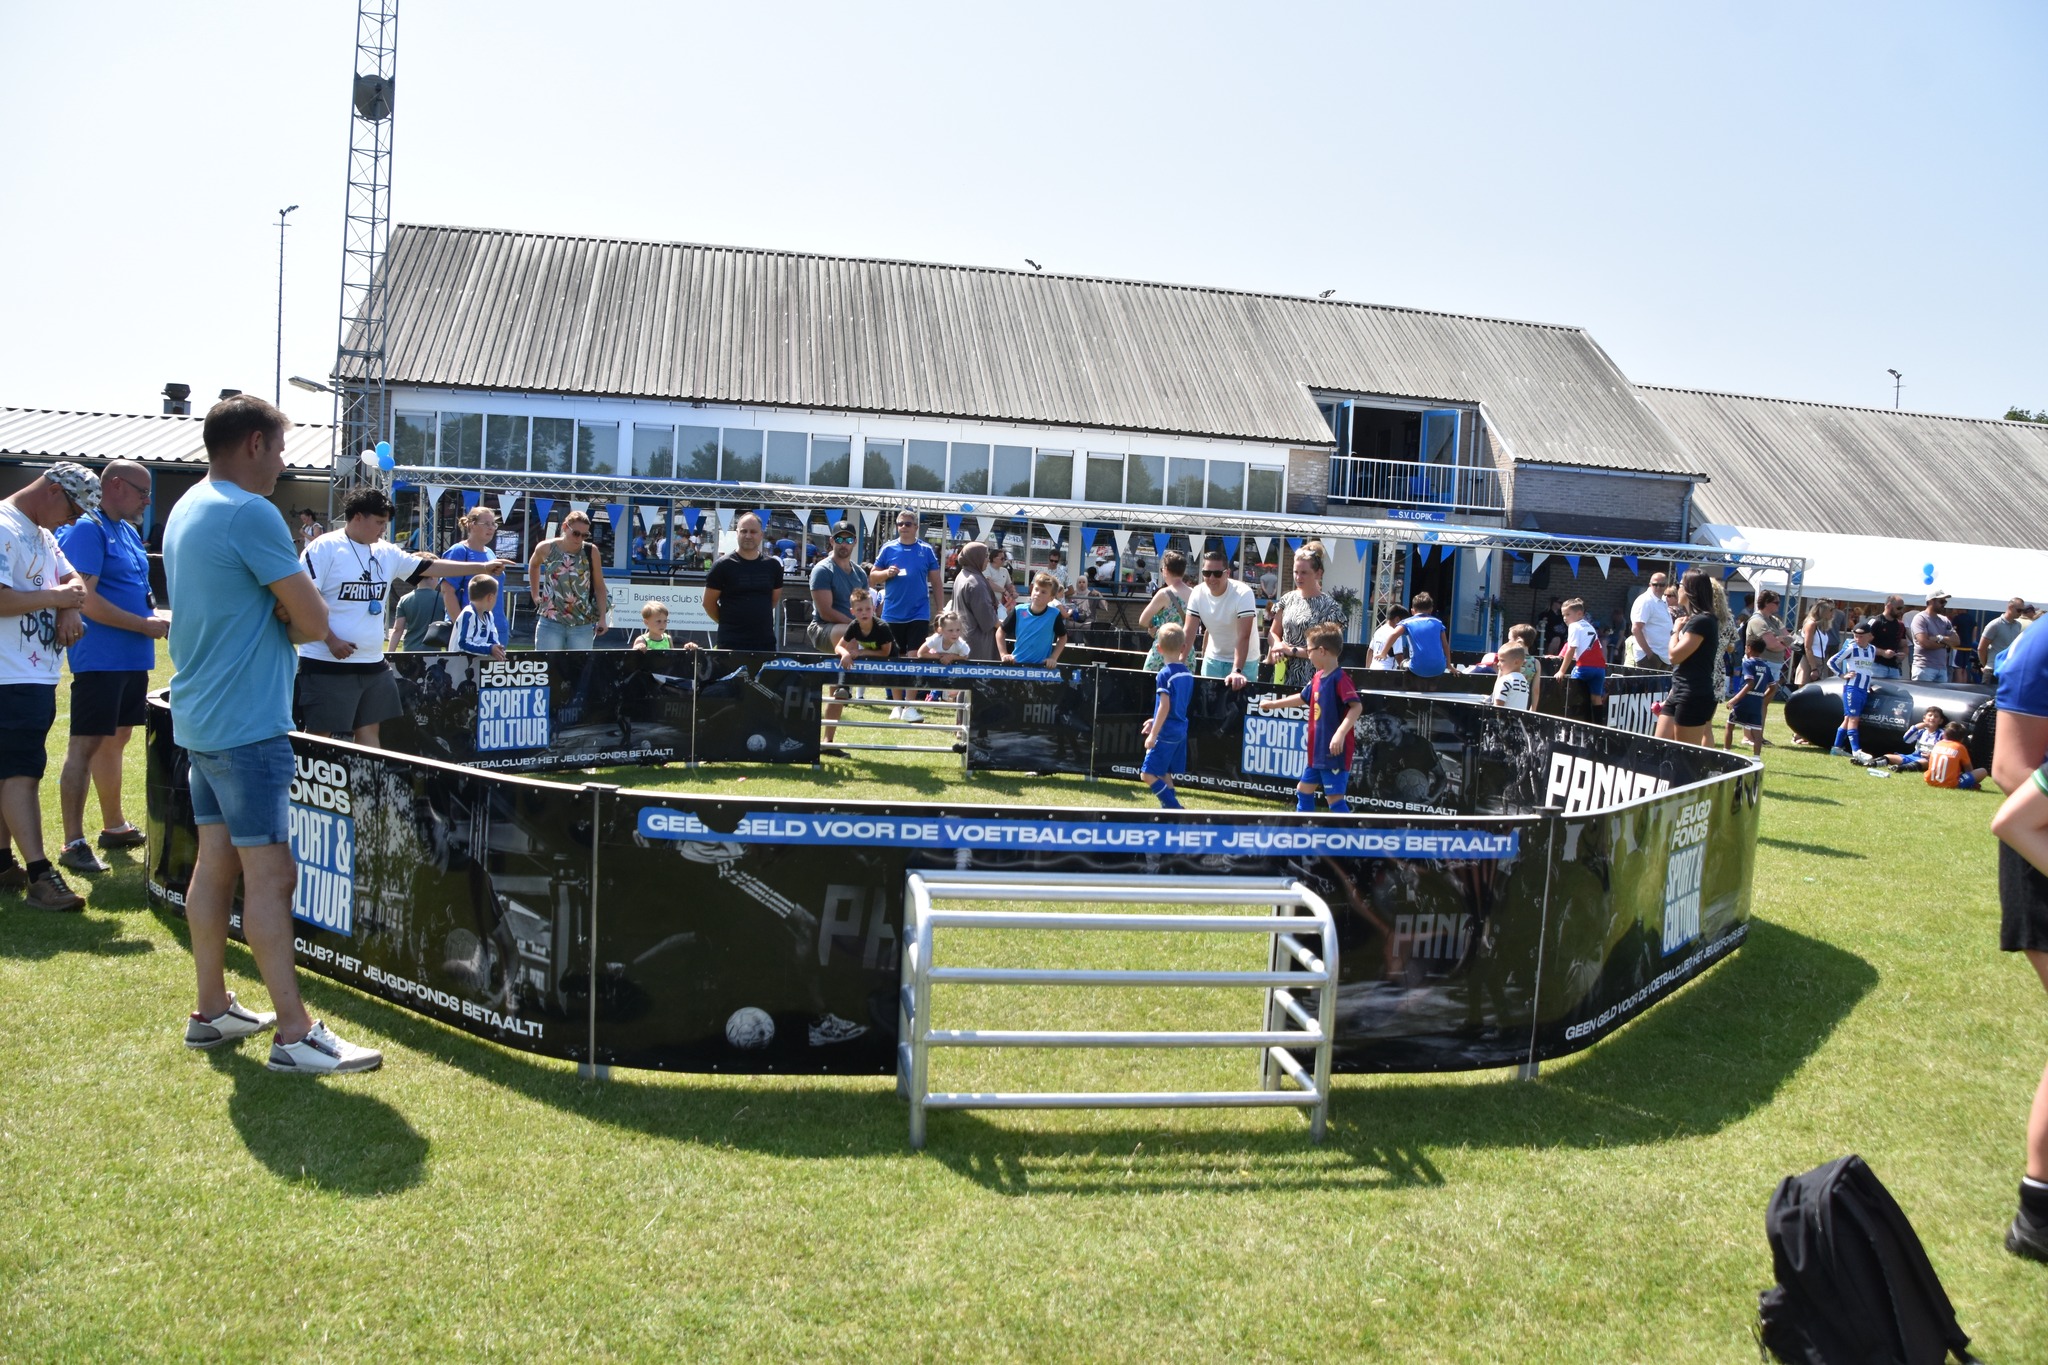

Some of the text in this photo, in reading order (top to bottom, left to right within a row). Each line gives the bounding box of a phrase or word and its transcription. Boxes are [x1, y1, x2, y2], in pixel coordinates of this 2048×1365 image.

[1411, 512, 1432, 520] LOPIK
[634, 592, 670, 603] Business
[672, 594, 692, 604] Club
[480, 660, 549, 674] JEUGD
[480, 674, 549, 688] FONDS
[834, 662, 922, 674] VETBALCLUB?
[924, 666, 946, 674] HET
[948, 666, 1024, 678] JEUGDFONDS
[1754, 672, 1764, 690] 7
[479, 688, 547, 719] SPORT &
[479, 717, 548, 750] CULTUUR
[1244, 718, 1299, 749] SPORT
[538, 756, 560, 764] HET
[560, 751, 628, 763] JEUGDFONDS
[629, 748, 674, 758] BETAALT!
[1930, 753, 1949, 783] 10
[289, 780, 350, 814] ONDS
[1112, 765, 1140, 774] GEEN
[1171, 772, 1199, 782] VOOR
[1200, 776, 1214, 785] DE
[1216, 778, 1298, 796] VOETBALCLUB?
[1405, 802, 1458, 816] BETAALT!
[1676, 799, 1712, 828] JEUGD
[288, 805, 351, 875] PORT &
[812, 821, 896, 840] VOOR
[900, 824, 939, 841] DE
[944, 824, 1160, 846] VOETBALCLUB?
[1165, 830, 1218, 848] HET
[1221, 830, 1401, 852] JEUGDFONDS
[1404, 834, 1513, 853] BETAALT!
[1671, 819, 1709, 850] FONDS
[1666, 848, 1696, 903] SPORT
[291, 860, 351, 932] LTUUR
[1662, 890, 1700, 953] CULTUUR
[166, 889, 187, 907] GEL
[335, 951, 362, 973] HET
[363, 963, 460, 1012] JEUGDFONDS
[462, 1000, 544, 1039] BETAALT!
[1565, 1017, 1598, 1041] GEEN
[1597, 1005, 1618, 1028] GELD
[1618, 992, 1639, 1014] VOOR
[1638, 986, 1649, 1002] DE
[1648, 956, 1692, 995] VOETBALCLUB?
[1692, 950, 1704, 966] HET
